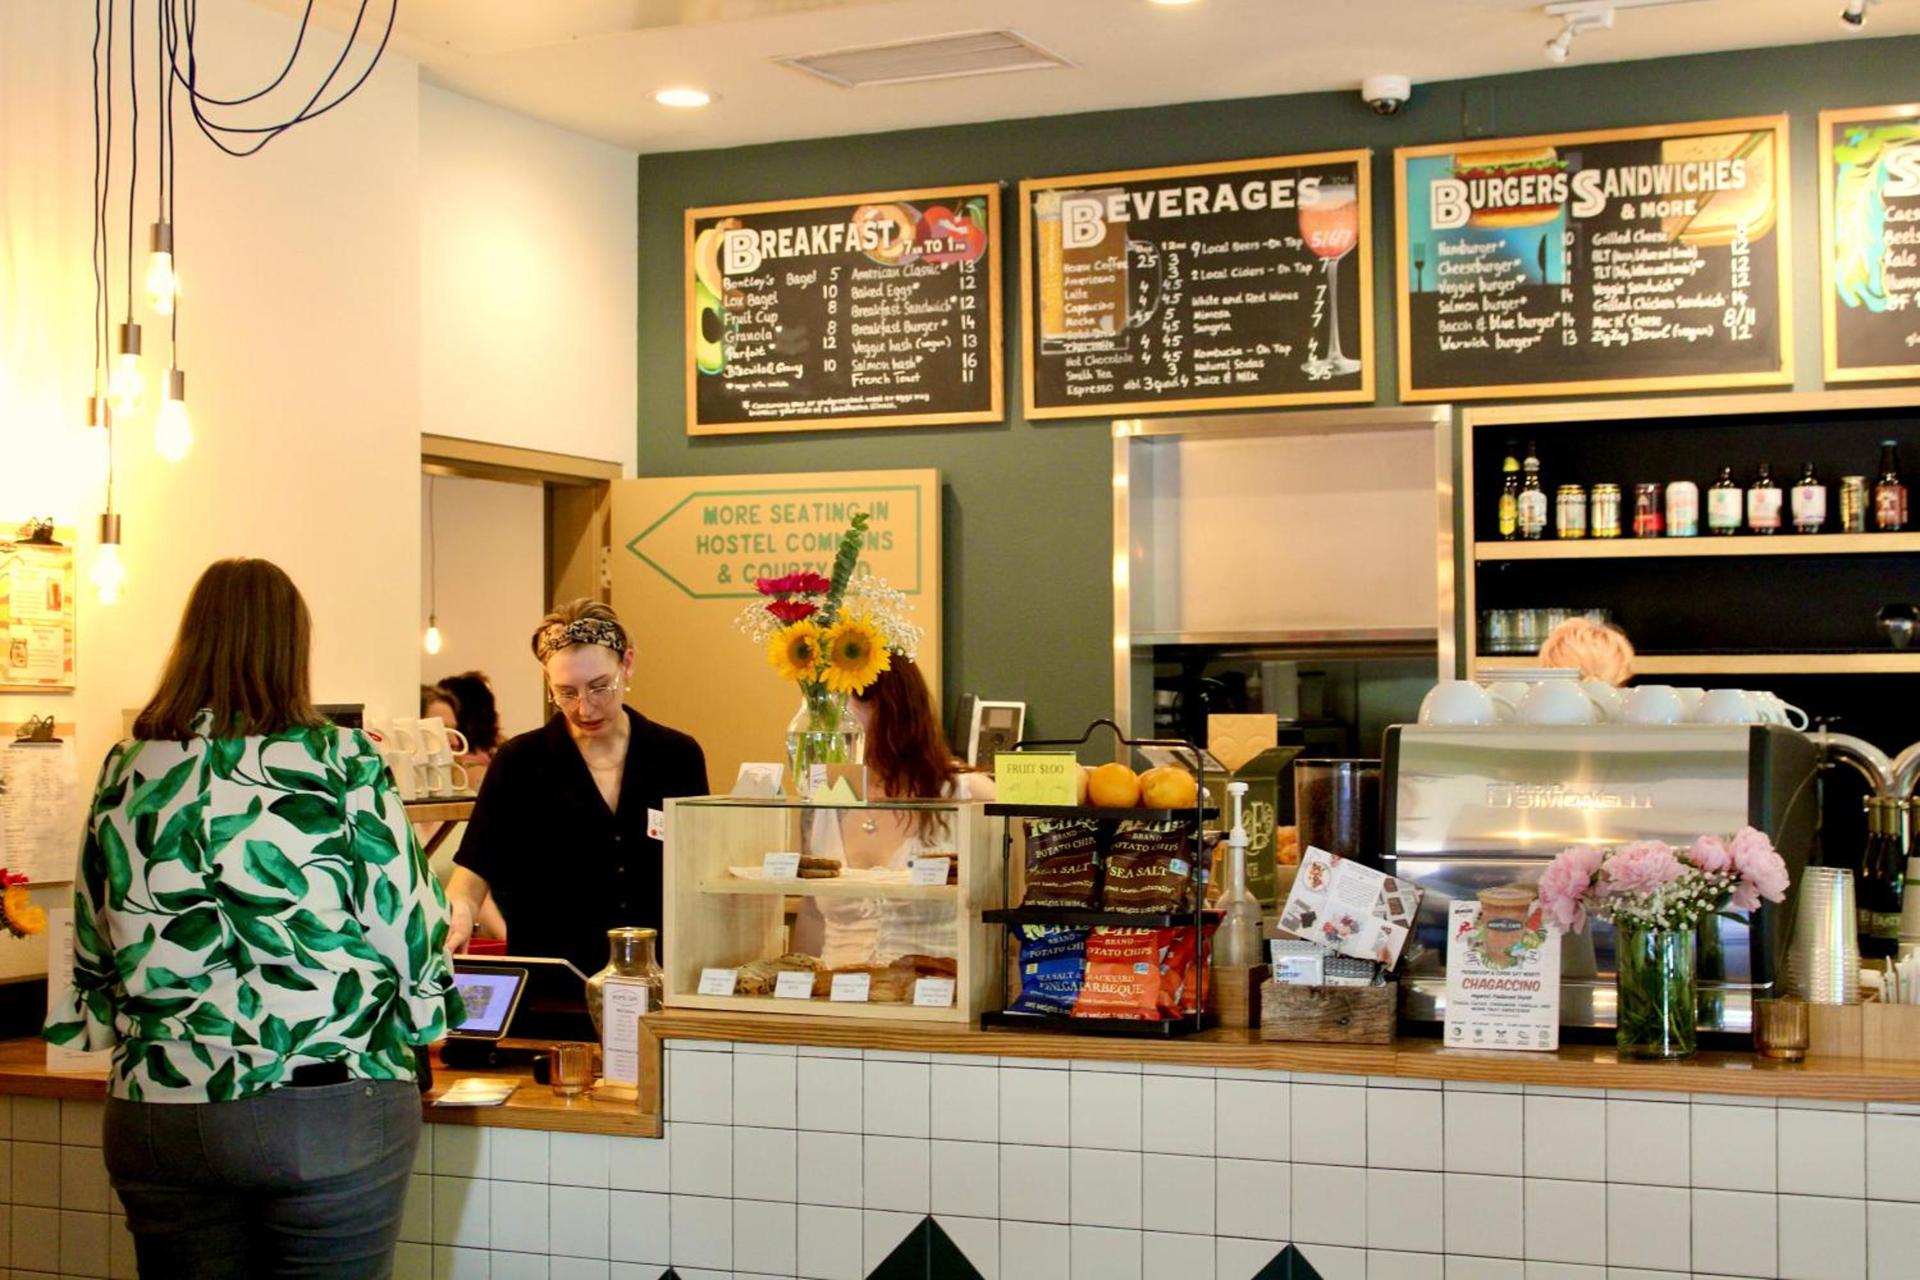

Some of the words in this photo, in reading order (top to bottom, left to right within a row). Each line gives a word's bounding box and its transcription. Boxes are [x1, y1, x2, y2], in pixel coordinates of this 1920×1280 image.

[1430, 172, 1569, 231] BURGERS
[1571, 158, 1747, 218] SANDWICHES
[1061, 177, 1323, 249] BEVERAGES
[1620, 205, 1637, 220] &
[1640, 199, 1697, 219] MORE
[1202, 242, 1230, 255] Local
[1284, 236, 1303, 250] Tap
[1592, 229, 1631, 246] Grilled
[723, 220, 895, 275] BREAKFAST
[924, 239, 943, 253] TO
[1731, 238, 1750, 256] 12
[1168, 253, 1180, 267] 3
[1731, 256, 1750, 273] 12
[851, 267, 900, 280] American
[959, 259, 976, 274] 13
[1168, 266, 1180, 279] 3
[1191, 270, 1199, 281] 2
[1201, 268, 1227, 280] Local
[1230, 266, 1265, 278] Ciders
[1294, 262, 1313, 276] Tap
[1318, 257, 1330, 274] 7
[786, 269, 817, 289] Bagel
[829, 267, 842, 281] 5
[1731, 273, 1751, 289] 12
[886, 284, 913, 301] Eggs
[960, 276, 976, 290] 12
[1139, 281, 1149, 293] 4
[1222, 293, 1244, 305] and
[1316, 284, 1328, 301] 7
[747, 291, 778, 310] Bagel
[822, 285, 838, 299] 10
[960, 295, 976, 310] 12
[1138, 294, 1148, 306] 4
[1593, 297, 1632, 312] Grilled
[724, 310, 752, 326] Fruit
[755, 311, 779, 327] Cup
[828, 300, 838, 314] 8
[1164, 308, 1175, 320] 5
[1314, 300, 1325, 314] 7
[1438, 298, 1479, 314] Salmon
[961, 315, 975, 330] 14
[1311, 313, 1323, 328] 7
[1438, 319, 1473, 333] Bacon
[725, 327, 773, 343] Granola
[827, 320, 838, 335] 8
[1562, 329, 1578, 346] 13
[1731, 325, 1752, 341] 12
[822, 336, 838, 349] 12
[962, 334, 978, 348] 13
[1140, 334, 1150, 349] 4
[1272, 343, 1292, 356] Tap
[1308, 337, 1318, 352] 4
[823, 359, 837, 372] 10
[962, 352, 978, 368] 16
[1141, 351, 1151, 365] 4
[1233, 358, 1265, 369] Sodas
[1167, 363, 1178, 376] 3
[851, 372, 891, 388] French
[962, 369, 974, 382] 11
[1066, 384, 1114, 397] Espresso
[1143, 376, 1153, 391] 3
[1180, 374, 1189, 388] 4
[703, 504, 762, 525] MORE
[869, 501, 889, 521] IN
[696, 534, 776, 555] HOSTEL
[717, 563, 732, 584] &
[1006, 764, 1035, 775] FRUIT
[1060, 862, 1091, 874] SALT
[1109, 865, 1134, 880] SEA
[1135, 865, 1167, 878] SALT
[1462, 977, 1541, 993] CHAGACCINO
